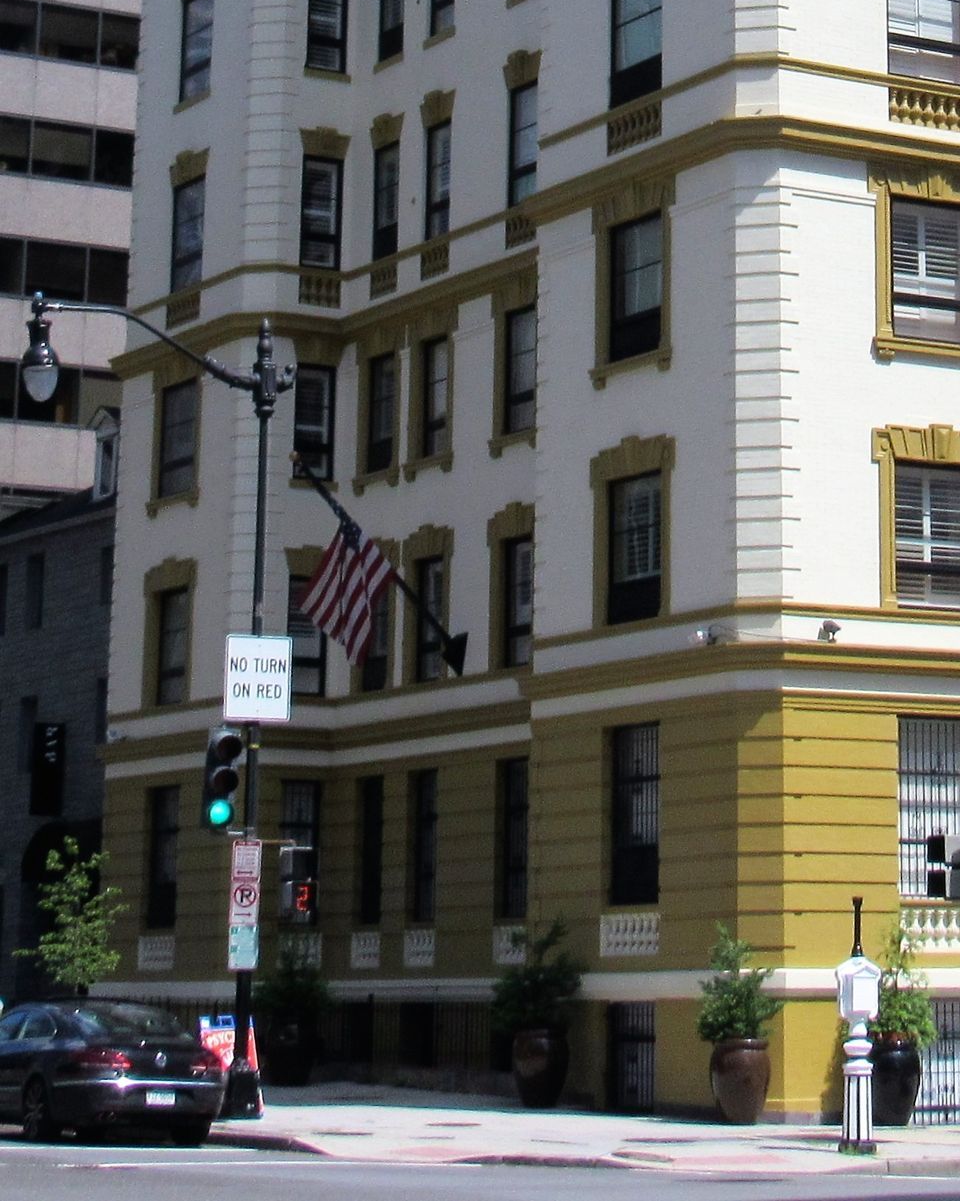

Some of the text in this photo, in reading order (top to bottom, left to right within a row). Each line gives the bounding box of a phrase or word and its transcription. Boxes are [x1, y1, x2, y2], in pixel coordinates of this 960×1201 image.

[230, 657, 287, 674] NO TURN
[233, 682, 282, 699] ON RED
